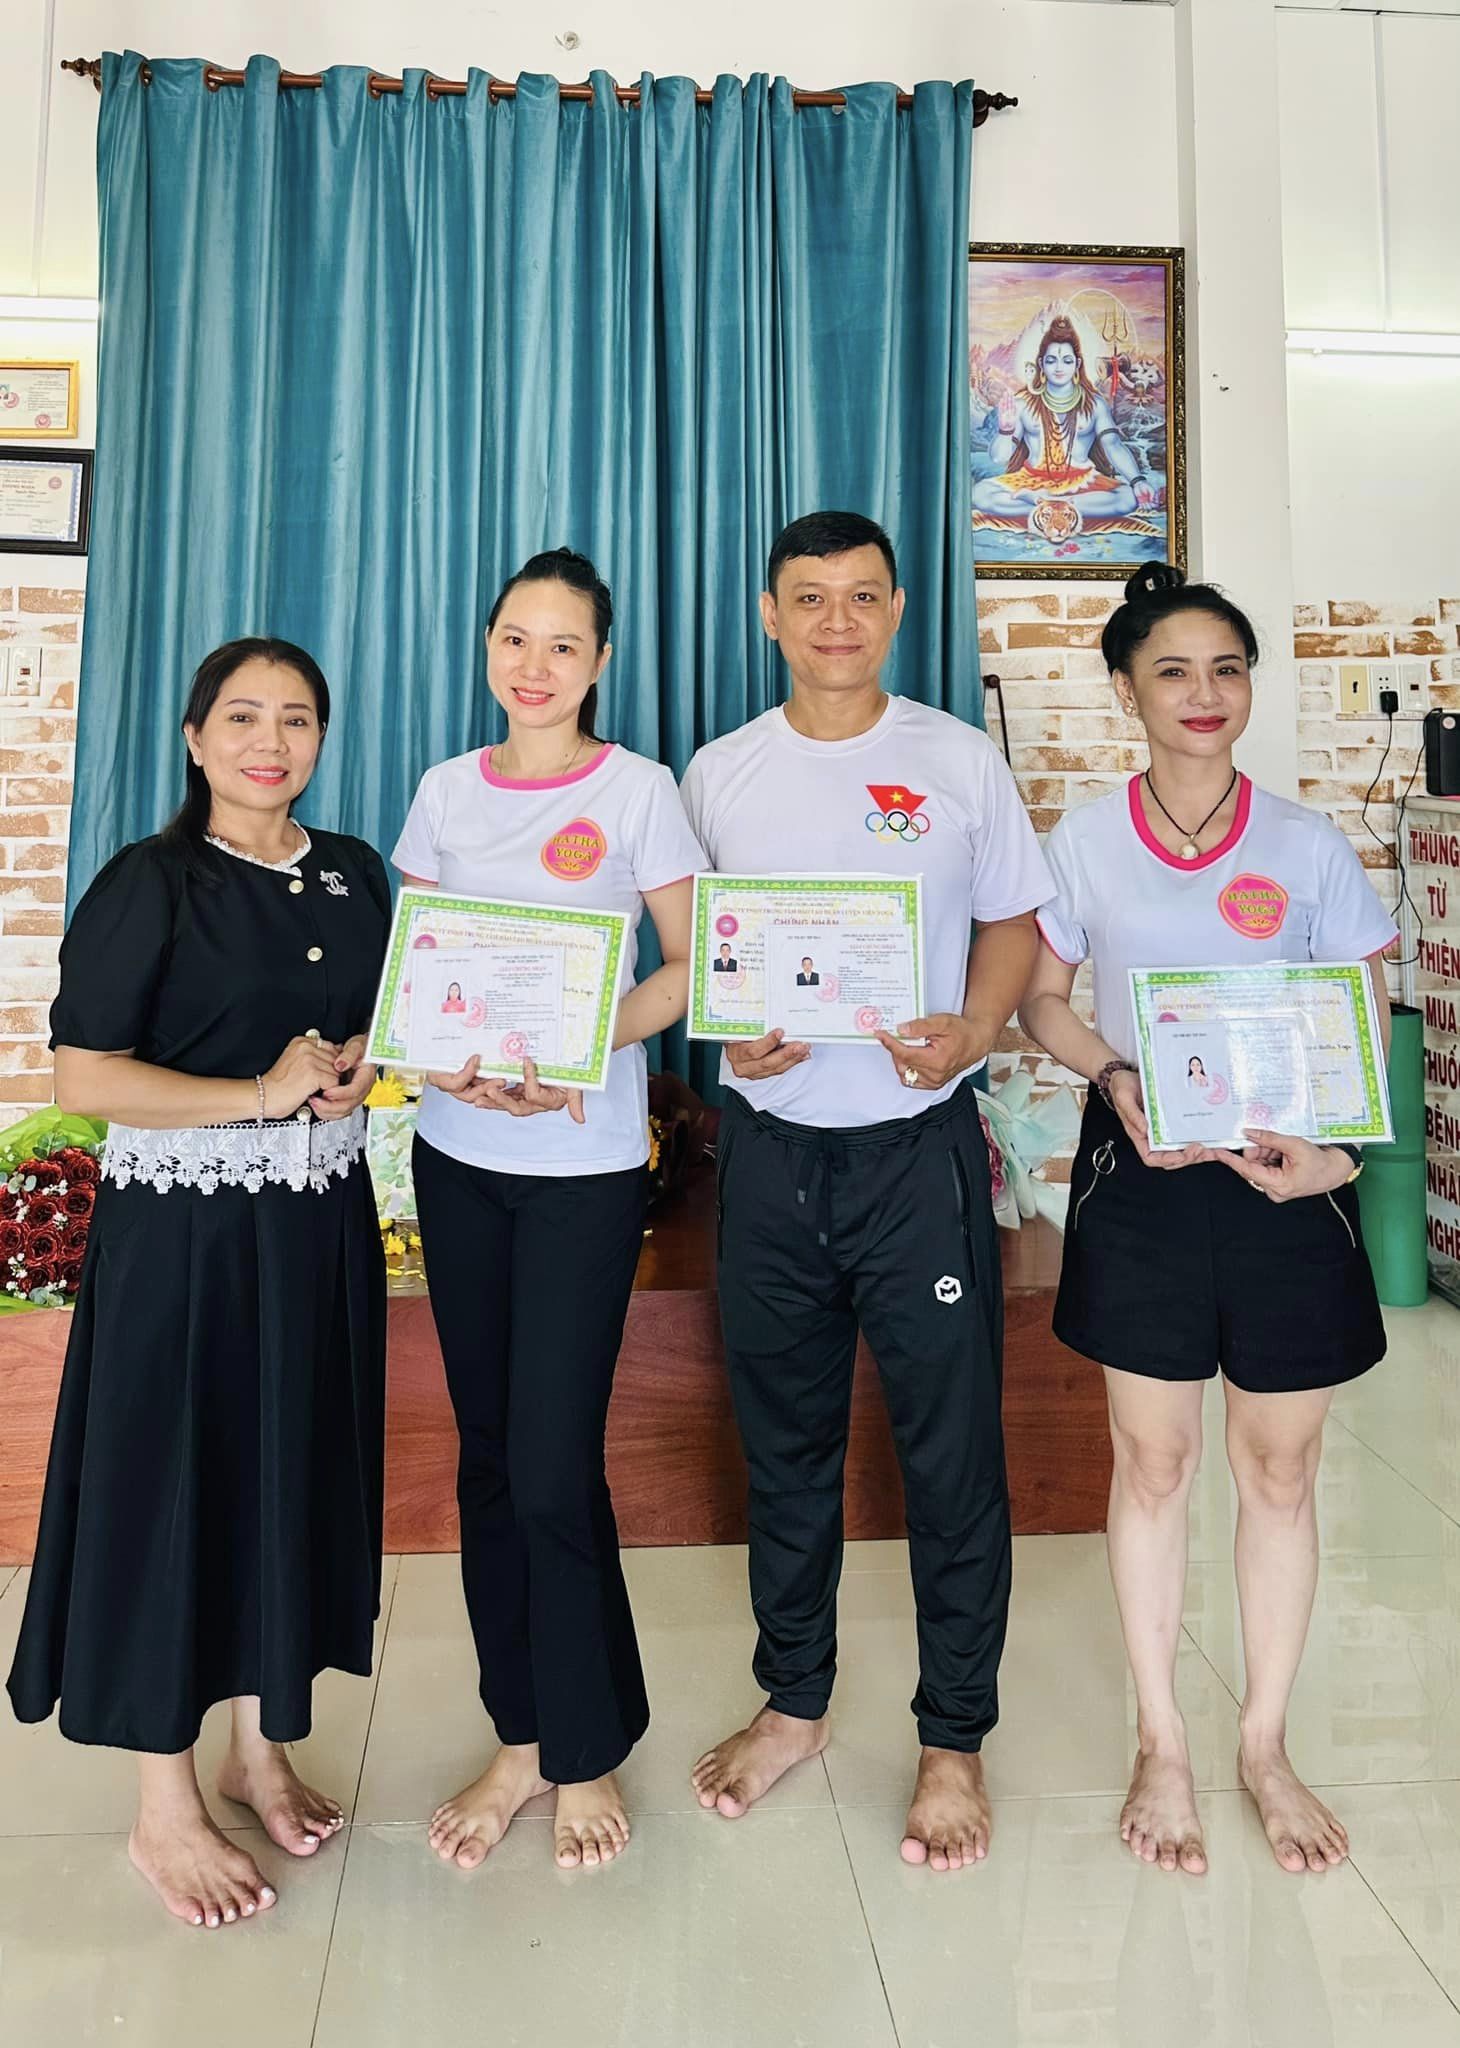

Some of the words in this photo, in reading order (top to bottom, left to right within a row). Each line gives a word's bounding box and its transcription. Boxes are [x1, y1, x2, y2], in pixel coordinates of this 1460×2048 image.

[556, 847, 592, 861] YOGA
[1410, 824, 1460, 868] THÙNG
[1239, 903, 1277, 915] YOGA
[1427, 877, 1447, 919] TỪ
[1417, 937, 1460, 986] THIỆN
[1426, 995, 1457, 1035] MUA
[1424, 1043, 1460, 1090] HUỐ
